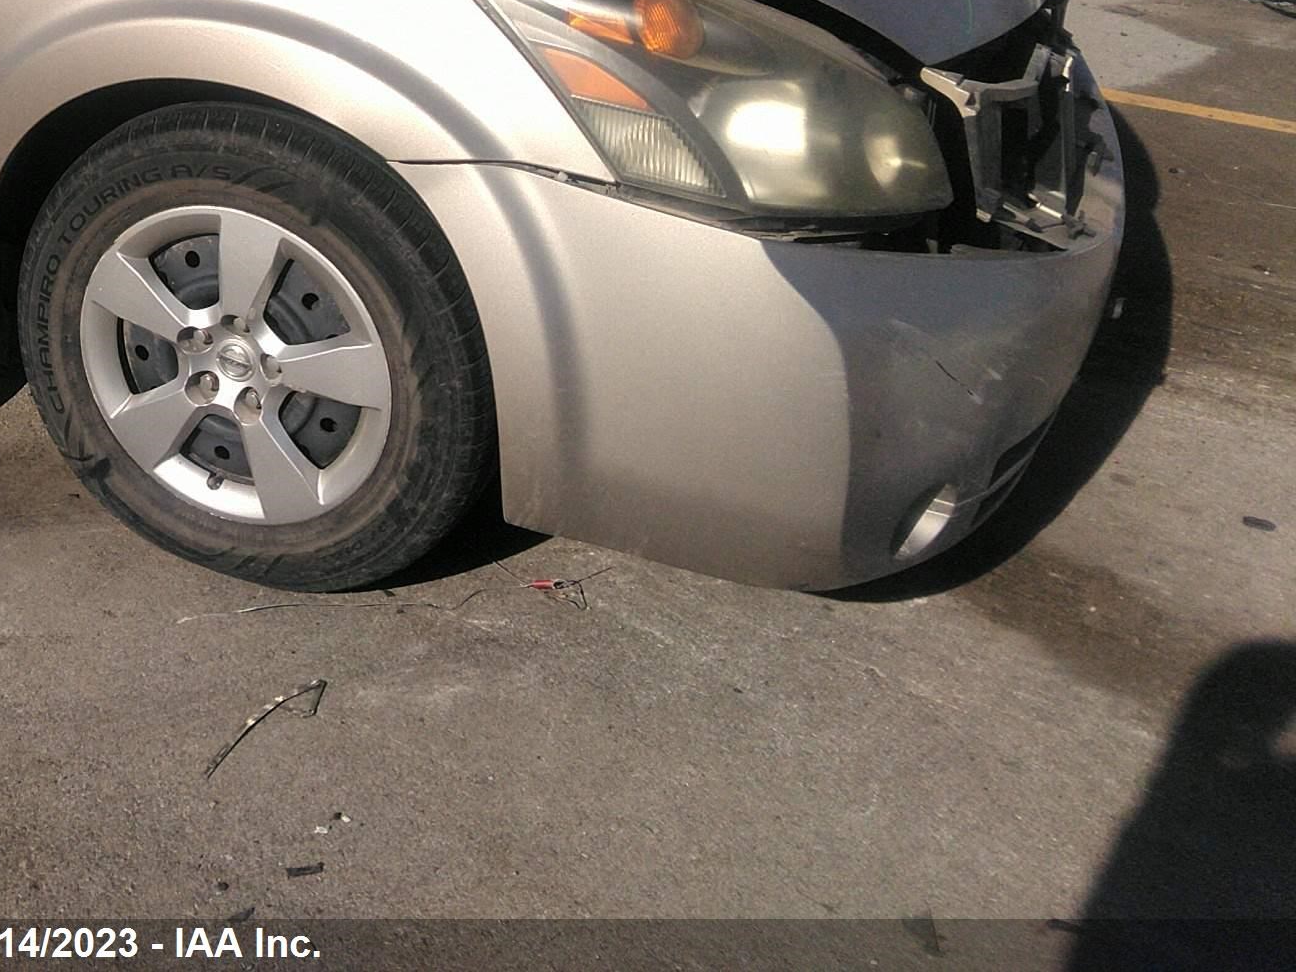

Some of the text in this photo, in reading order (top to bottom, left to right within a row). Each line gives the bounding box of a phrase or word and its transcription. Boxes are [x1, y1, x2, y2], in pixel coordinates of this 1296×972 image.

[37, 164, 231, 414] CHAMPIRO TOURING A/S
